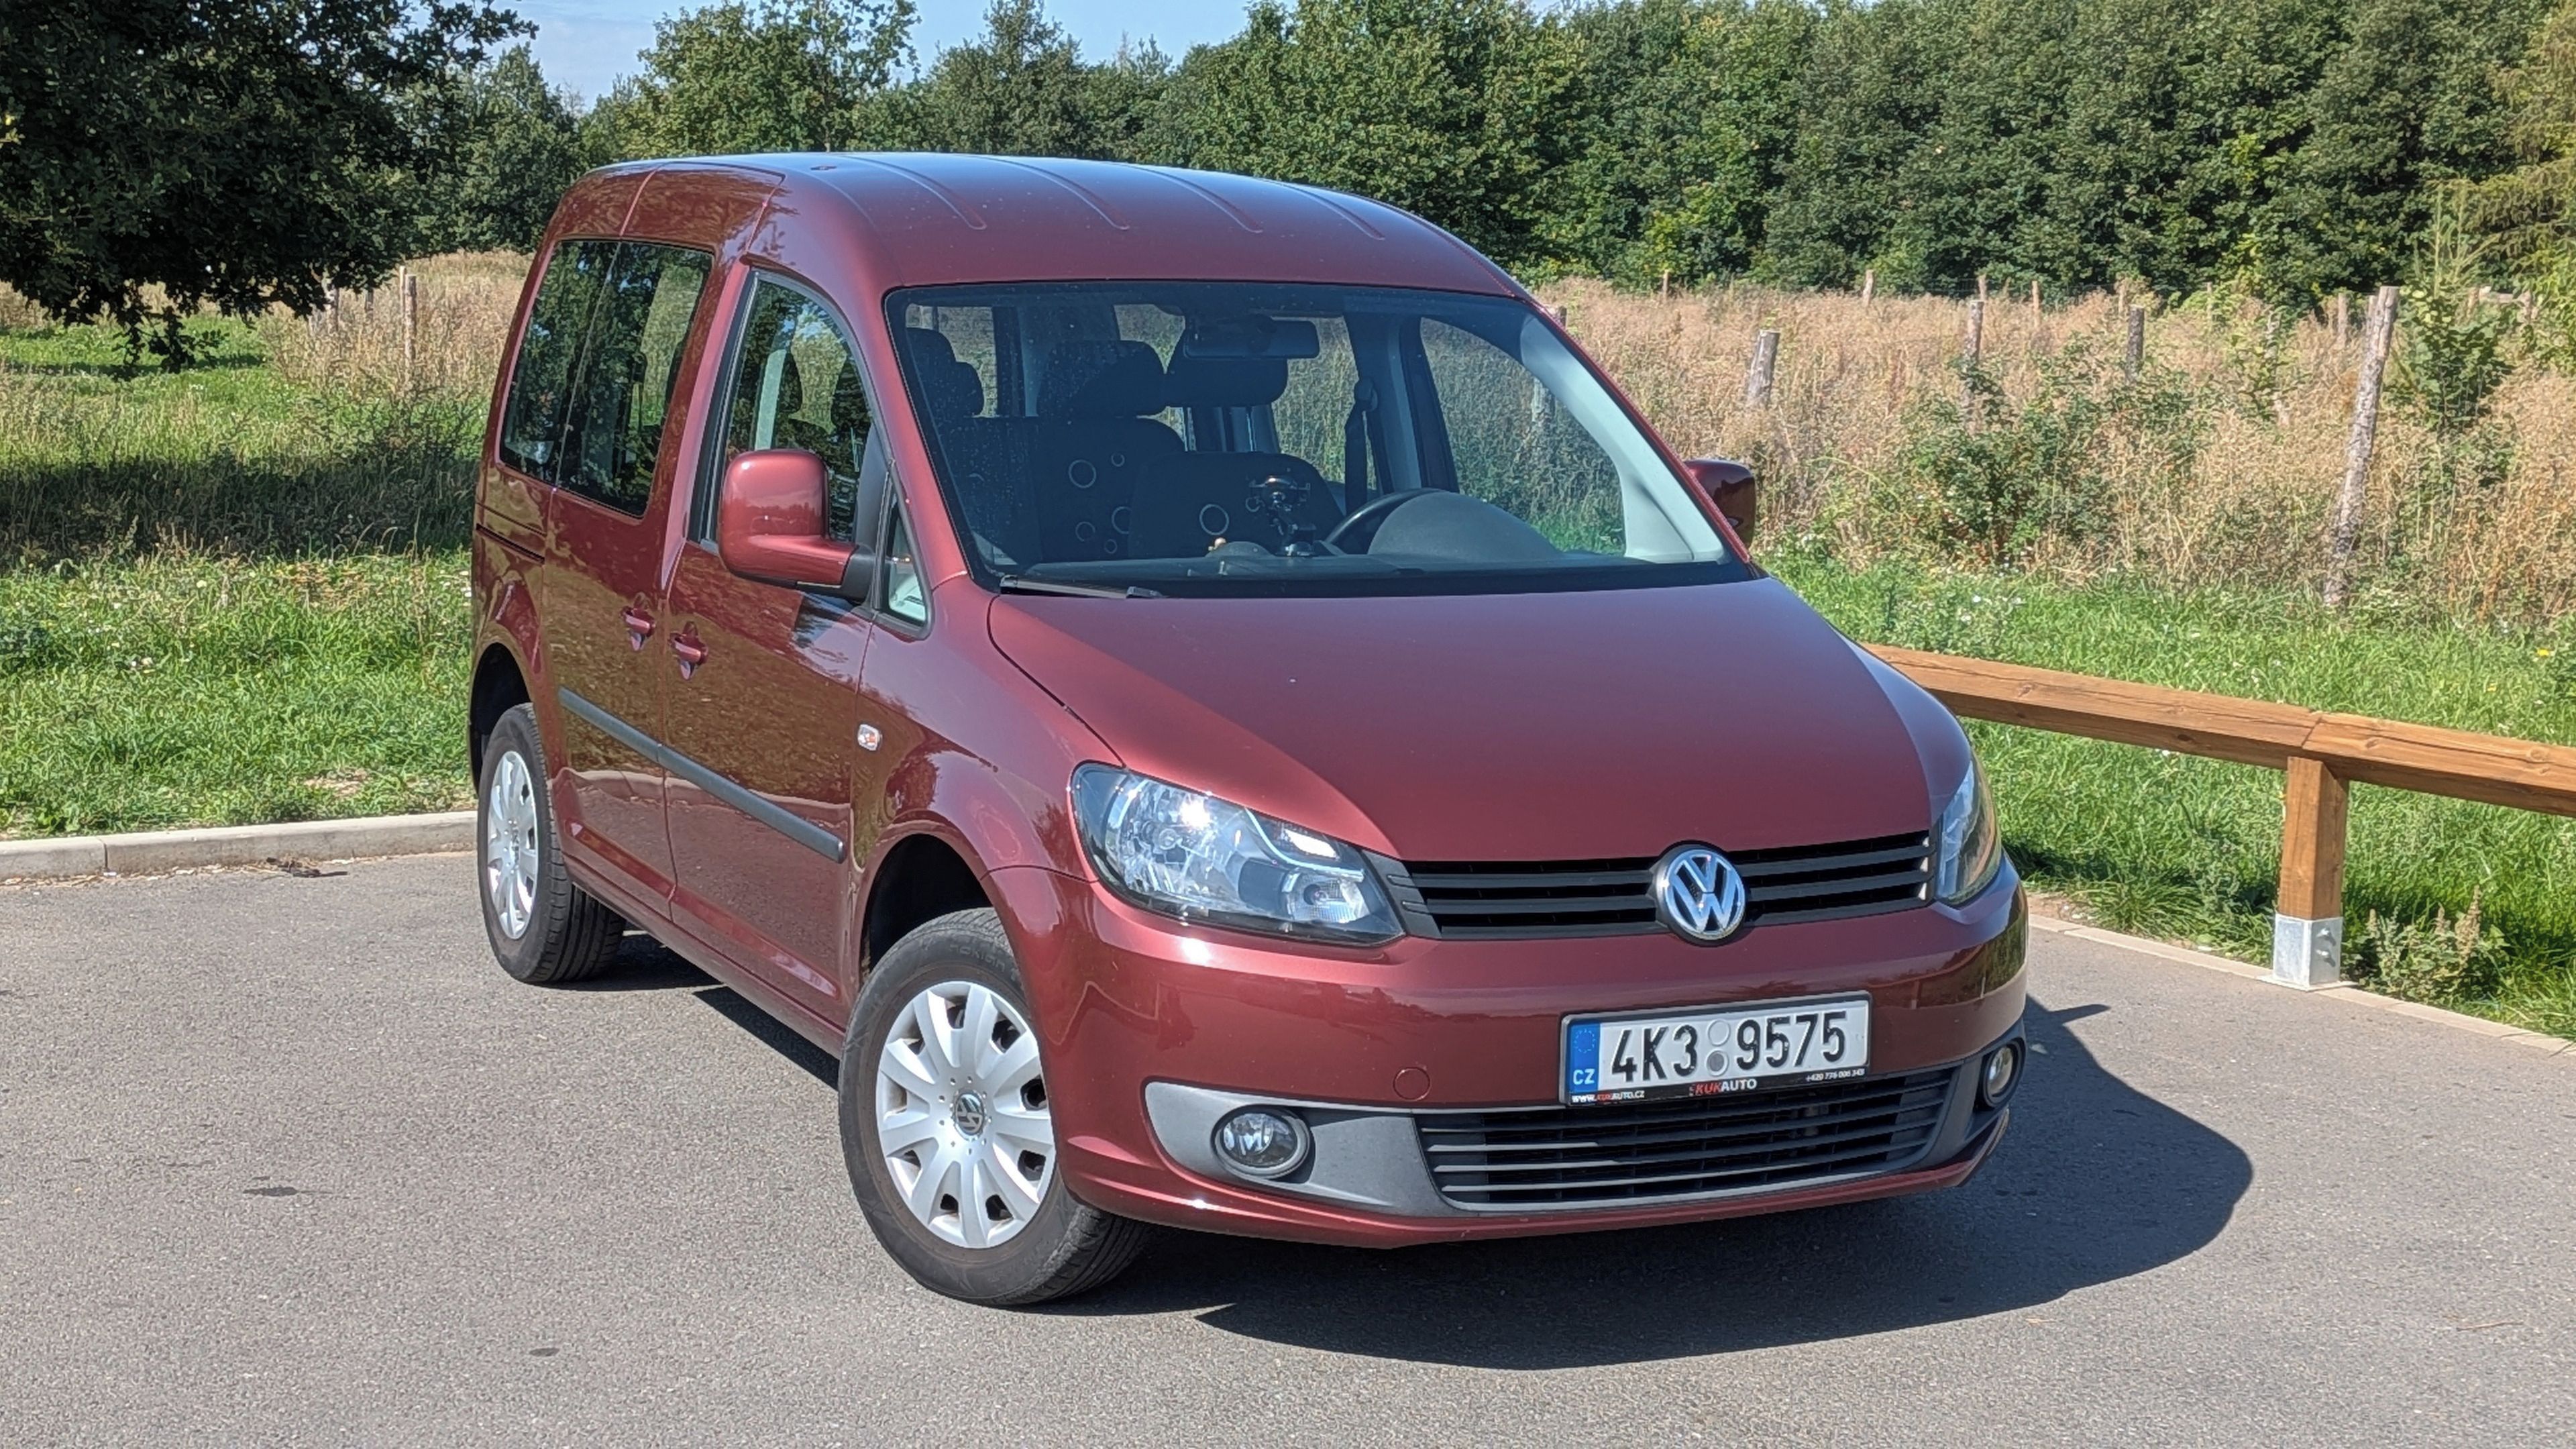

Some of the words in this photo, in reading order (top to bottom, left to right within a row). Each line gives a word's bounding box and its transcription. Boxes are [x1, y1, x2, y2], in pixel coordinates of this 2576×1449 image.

[1665, 849, 1745, 940] VW
[1611, 1024, 1697, 1082] 4K3
[1736, 1010, 1846, 1071] 9575
[1573, 1069, 1595, 1085] CZ
[1695, 1078, 1757, 1095] KUKAUTO
